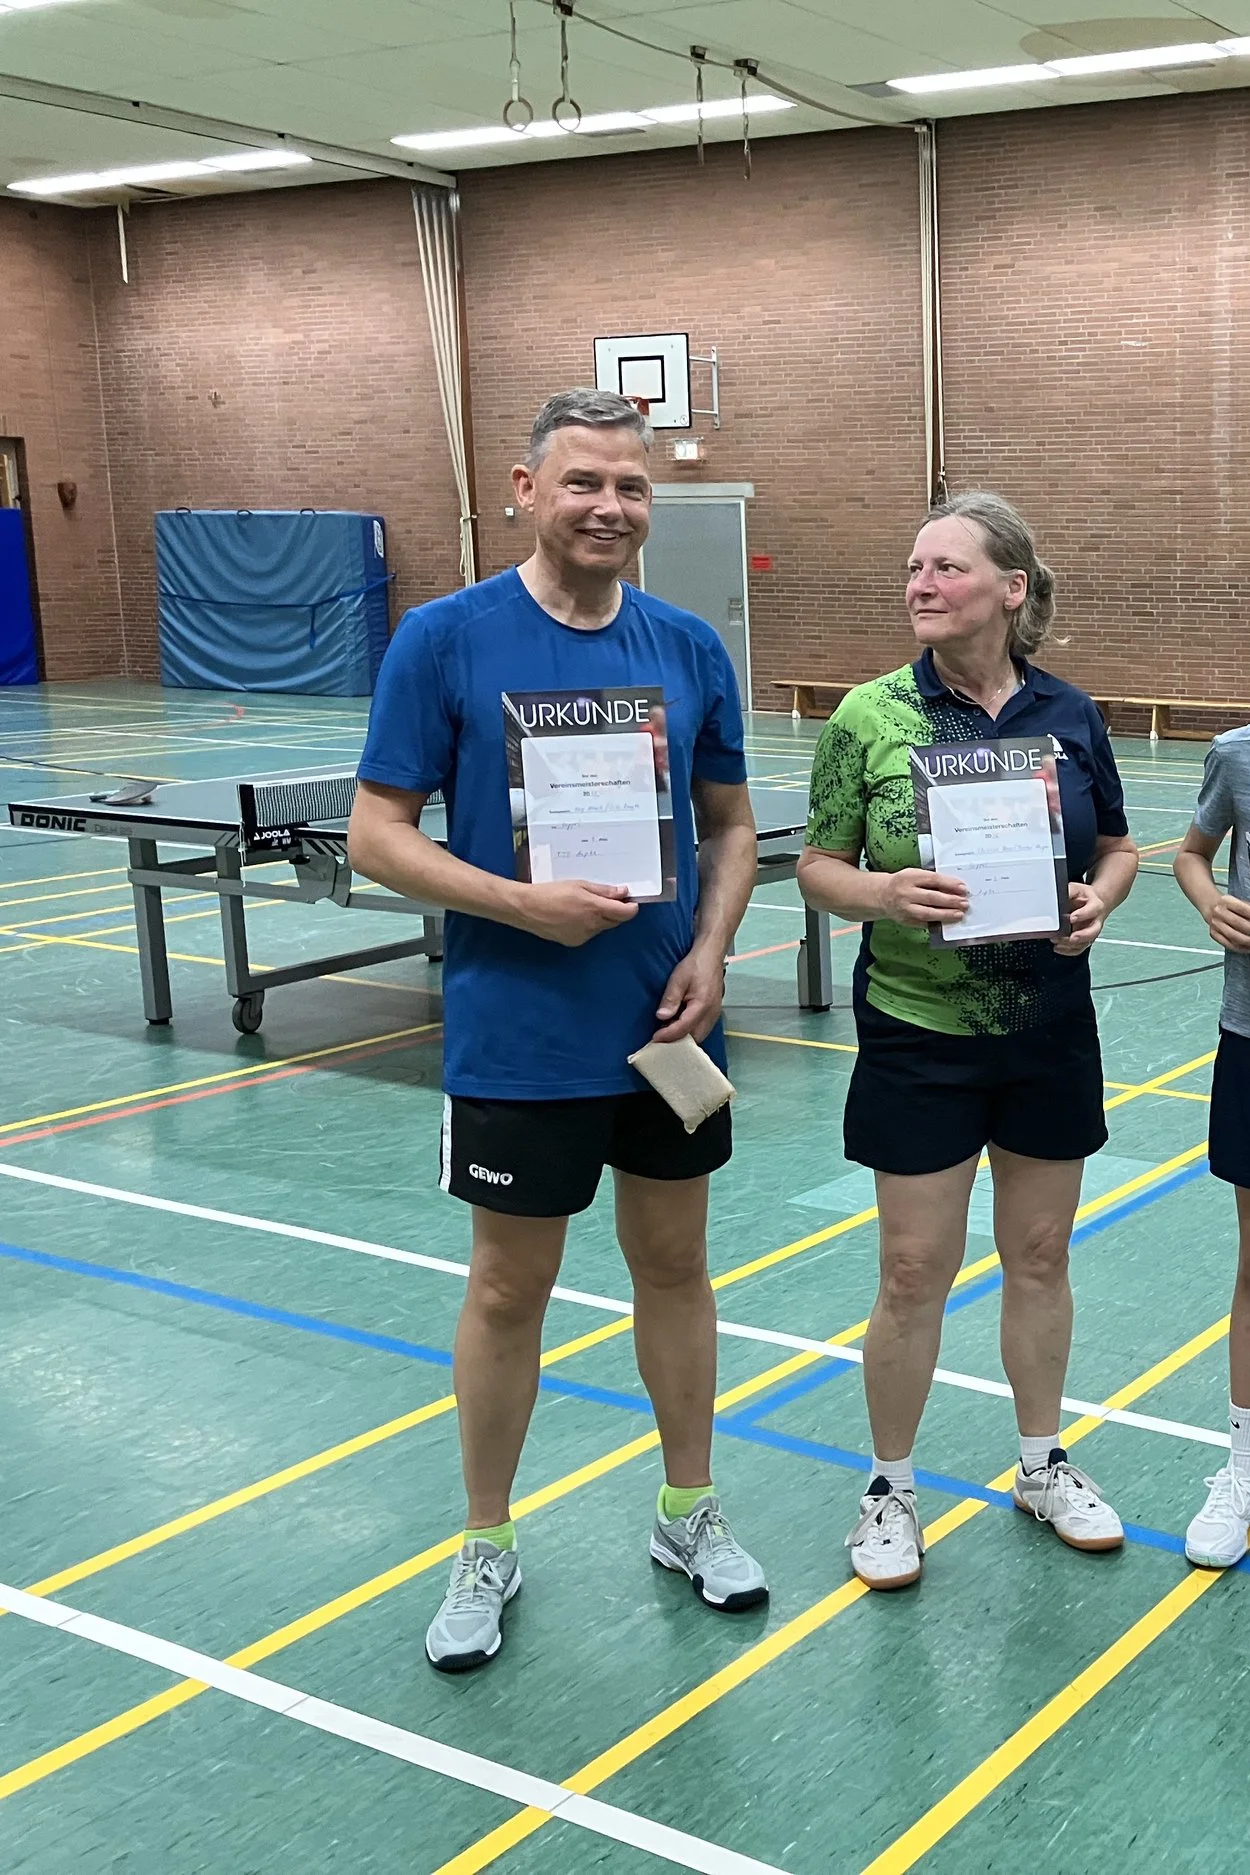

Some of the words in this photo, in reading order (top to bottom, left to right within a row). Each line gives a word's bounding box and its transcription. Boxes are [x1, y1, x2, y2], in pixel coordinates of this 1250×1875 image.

[519, 699, 650, 728] URKUNDE
[924, 748, 1043, 778] URKUNDE
[20, 812, 87, 833] DONIC
[261, 829, 291, 840] JOOLA
[469, 1163, 514, 1186] GEWO
